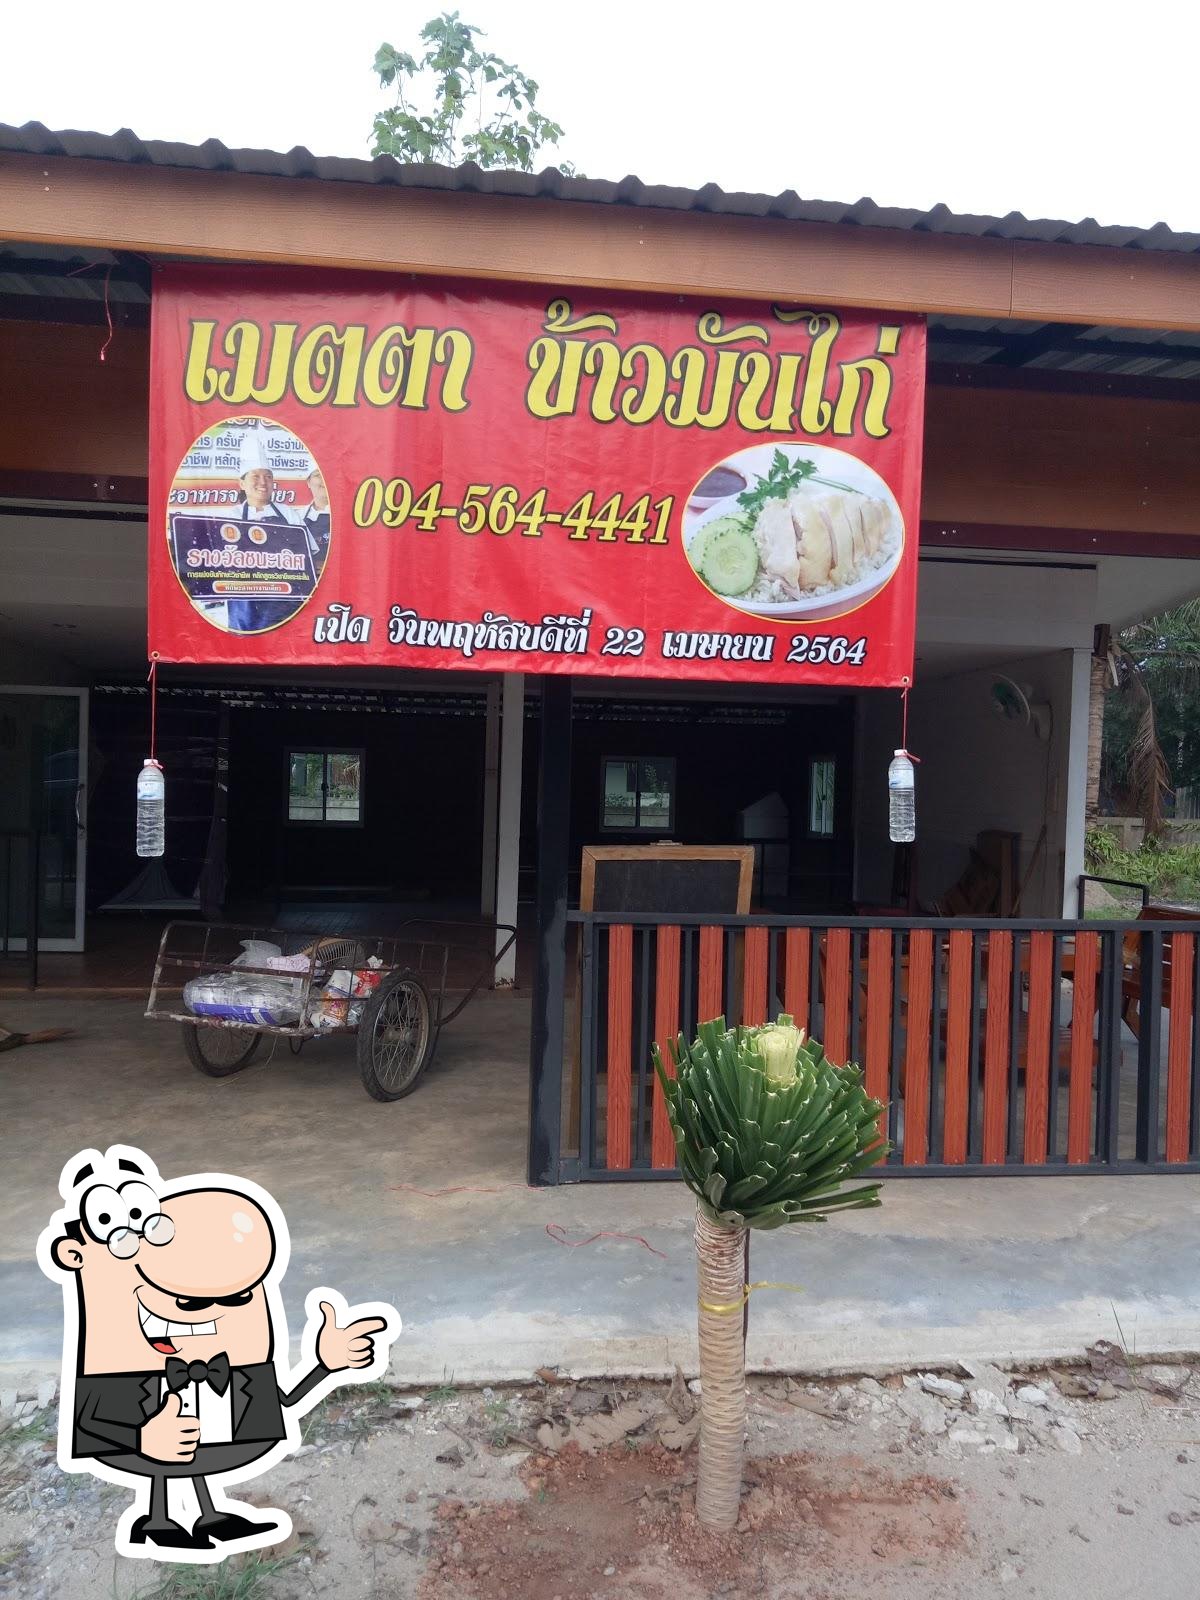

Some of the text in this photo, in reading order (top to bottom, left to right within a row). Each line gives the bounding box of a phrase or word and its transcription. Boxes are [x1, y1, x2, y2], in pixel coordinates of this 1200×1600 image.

[184, 297, 898, 439] เมตตา ข้าวมันไก่
[352, 476, 676, 545] 094-564-4441
[187, 545, 306, 570] รางวัลชนะเลิศ
[313, 603, 868, 667] เปิด วันพฤหัสบดีที่ 22 เมษายน 2564
